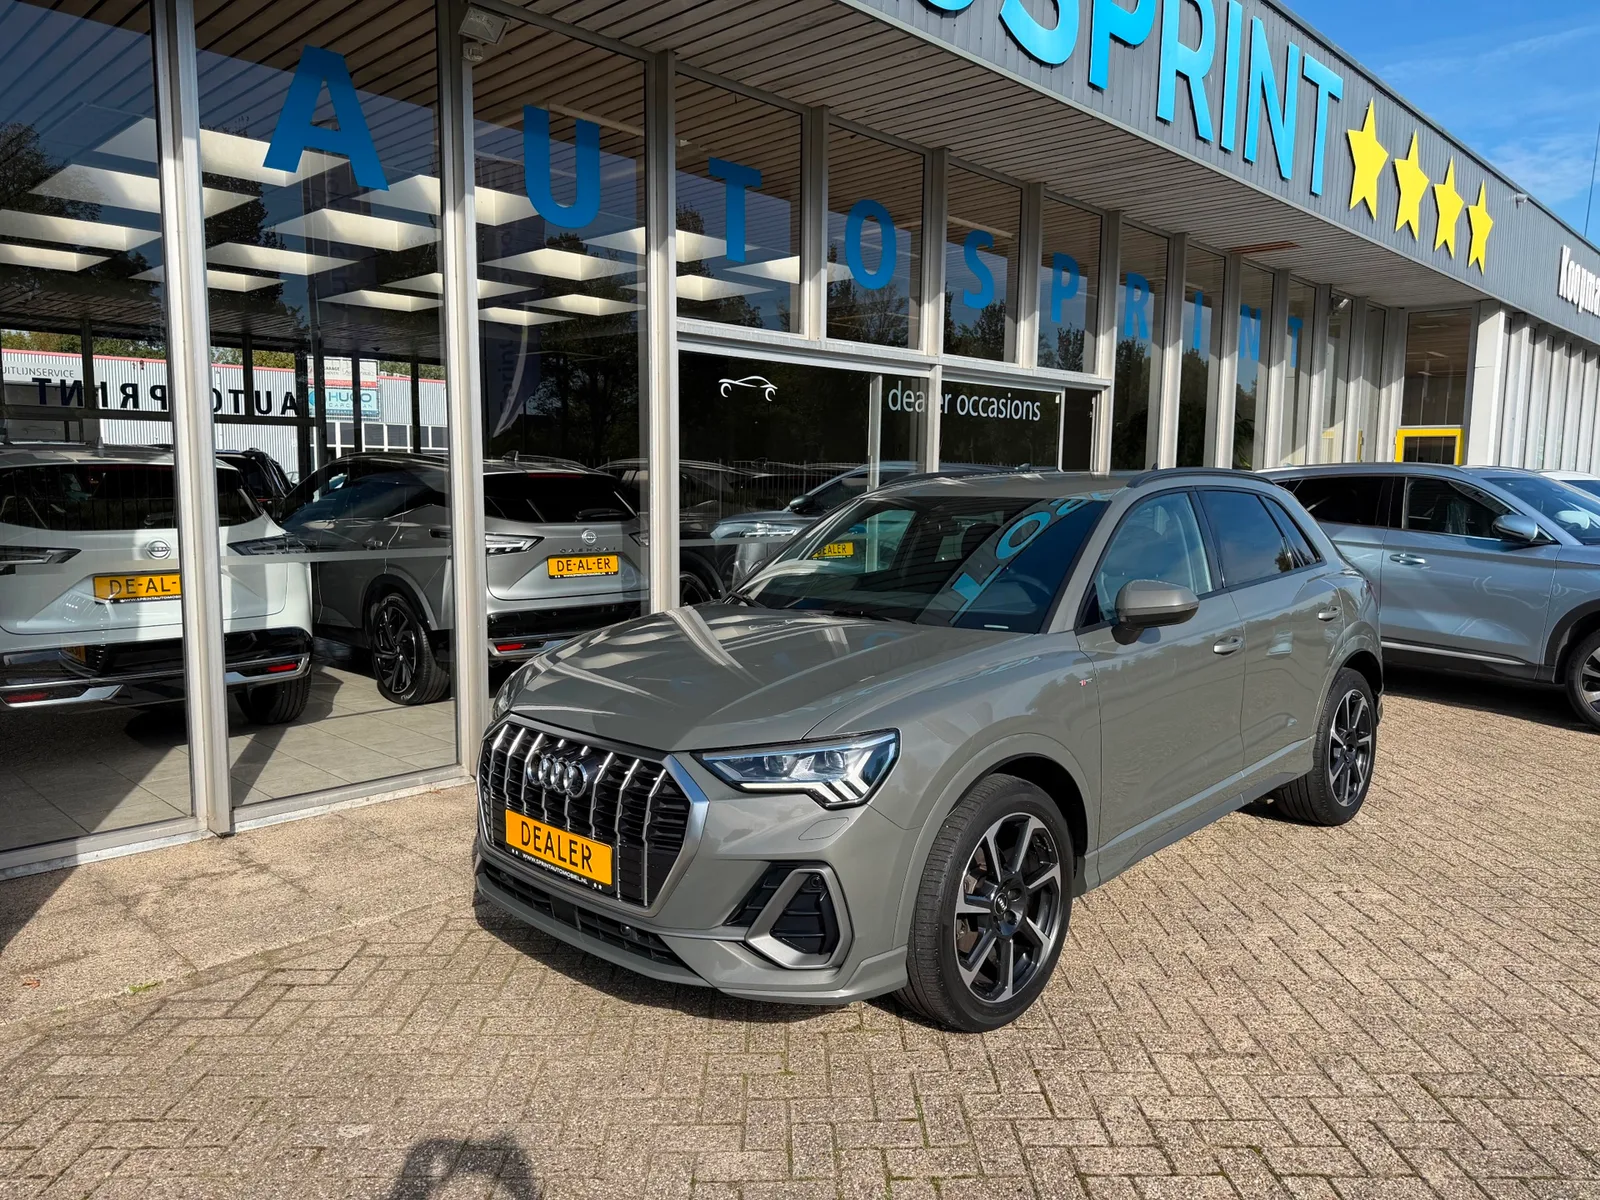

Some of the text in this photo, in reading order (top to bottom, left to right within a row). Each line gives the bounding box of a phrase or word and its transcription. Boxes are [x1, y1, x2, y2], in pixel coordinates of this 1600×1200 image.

[888, 380, 1041, 421] dear occasions
[557, 558, 611, 572] DE-AL-ER
[109, 576, 181, 596] DE-AL-
[521, 820, 593, 873] DEALER
